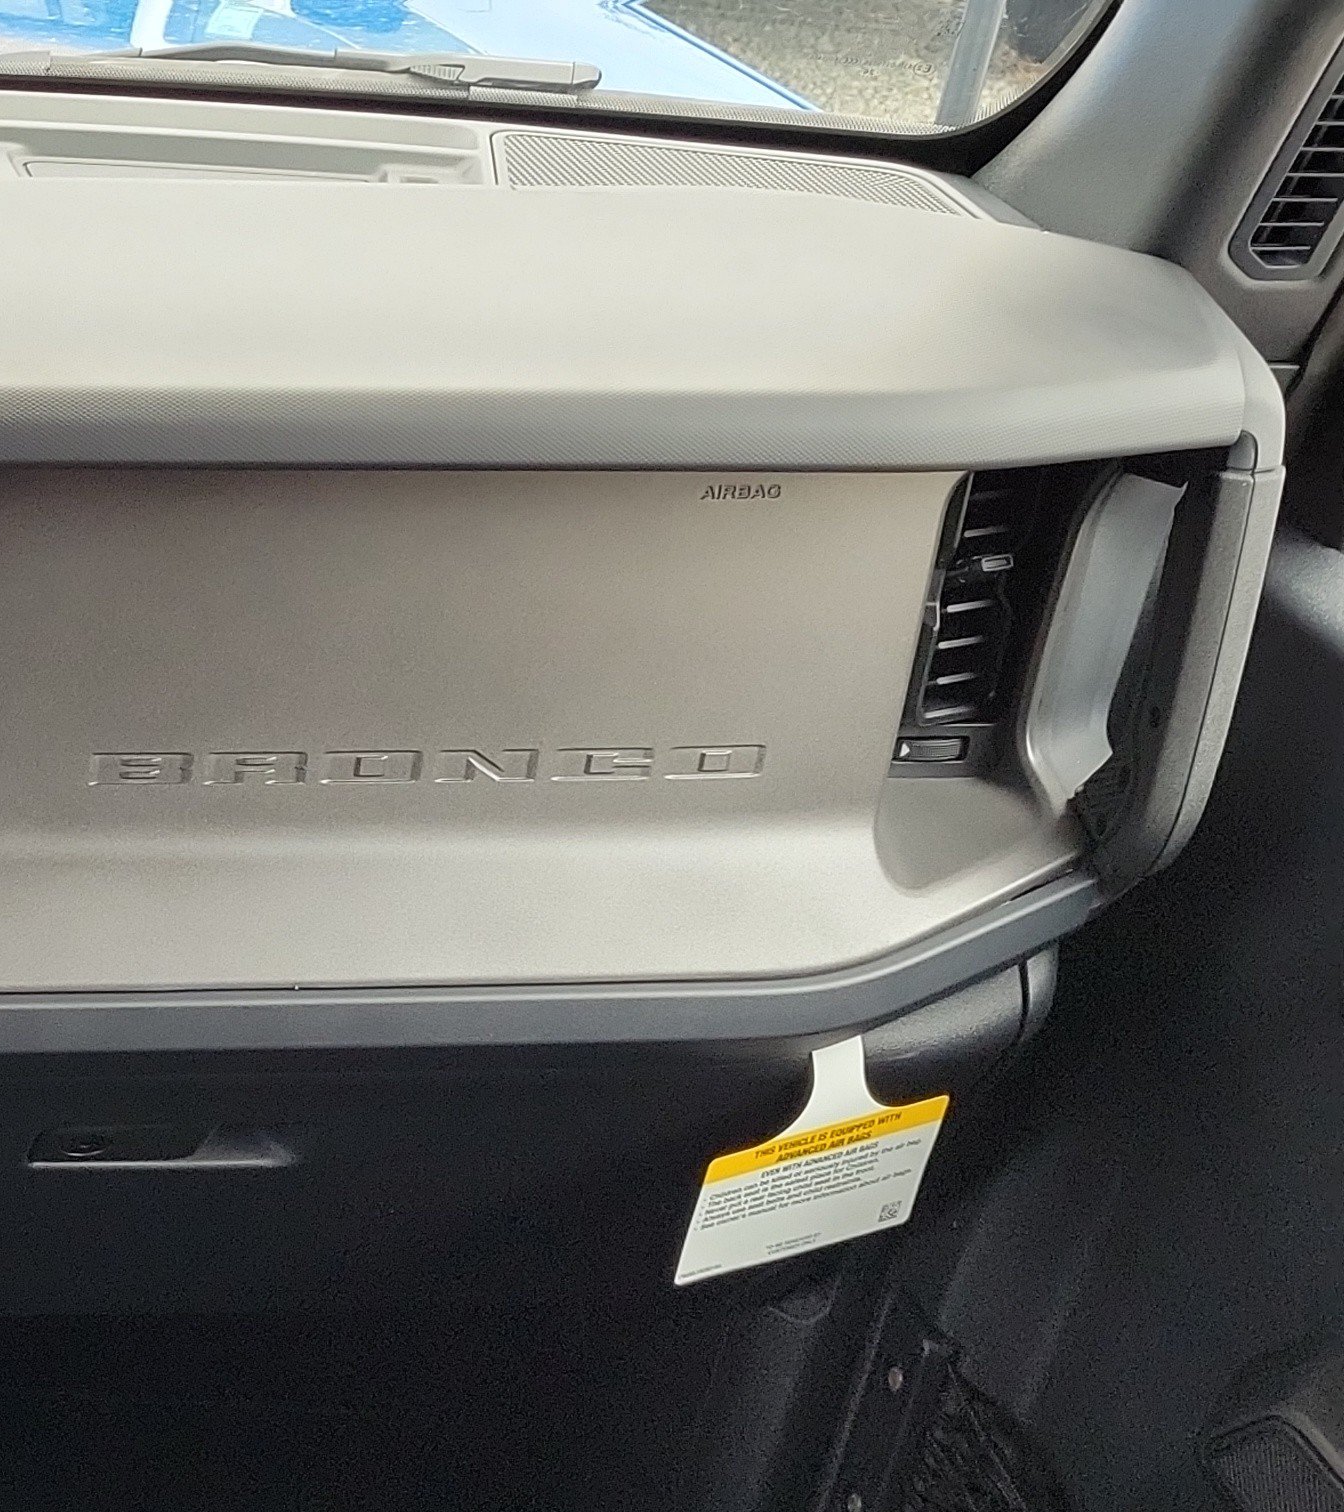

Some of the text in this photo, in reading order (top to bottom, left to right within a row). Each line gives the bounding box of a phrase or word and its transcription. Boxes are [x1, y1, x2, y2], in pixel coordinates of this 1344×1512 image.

[700, 484, 781, 500] AIRBAG
[87, 743, 767, 787] BRONCO
[754, 1112, 900, 1158] THIS VEHICLE IS EQUIPPED WITH
[776, 1131, 871, 1162] ADVANCED AIR BAGS
[781, 1162, 801, 1172] WITH
[803, 1151, 842, 1166] ADVANCED
[845, 1147, 858, 1155] AIR
